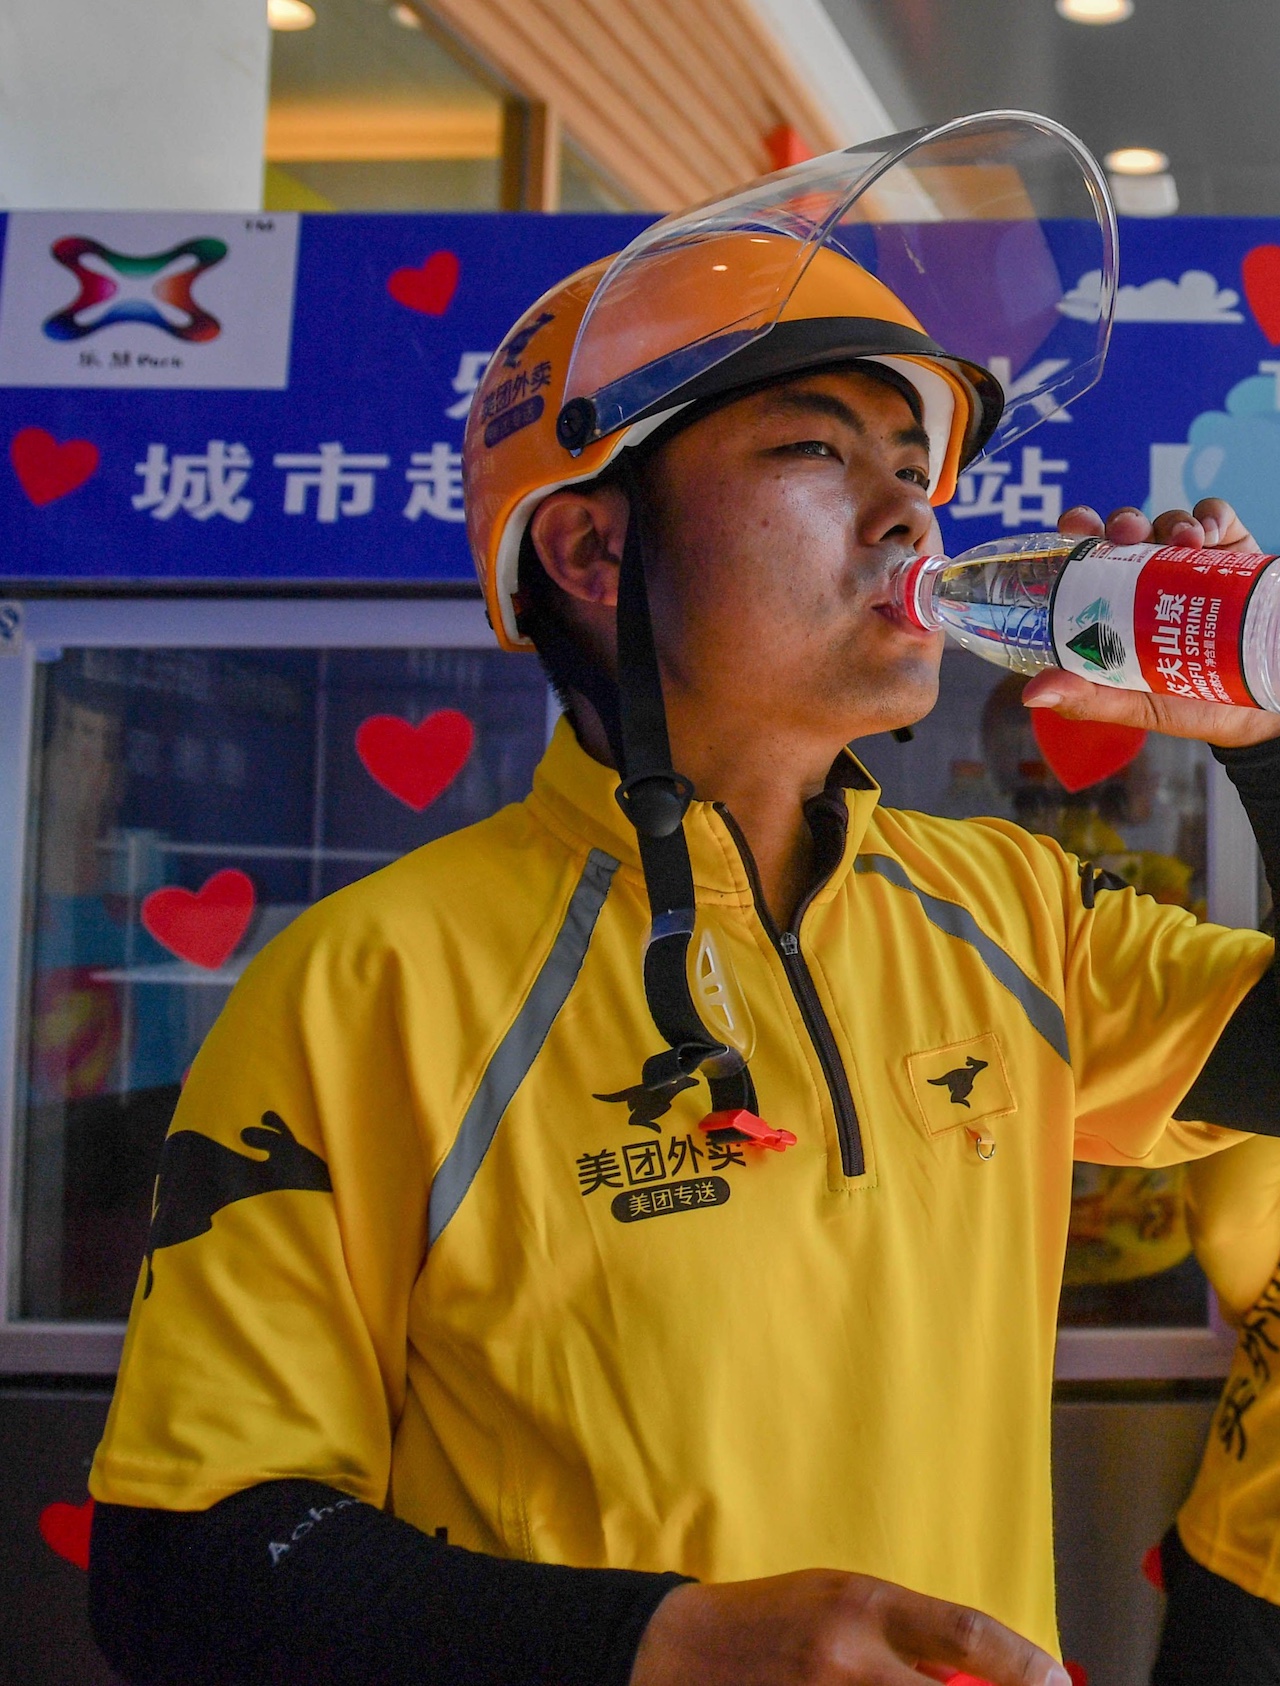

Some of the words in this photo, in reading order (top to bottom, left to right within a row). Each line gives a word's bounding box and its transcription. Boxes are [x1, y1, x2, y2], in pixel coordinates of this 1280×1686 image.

[1185, 596, 1206, 657] SPRING
[627, 1181, 718, 1218] 美团专送
